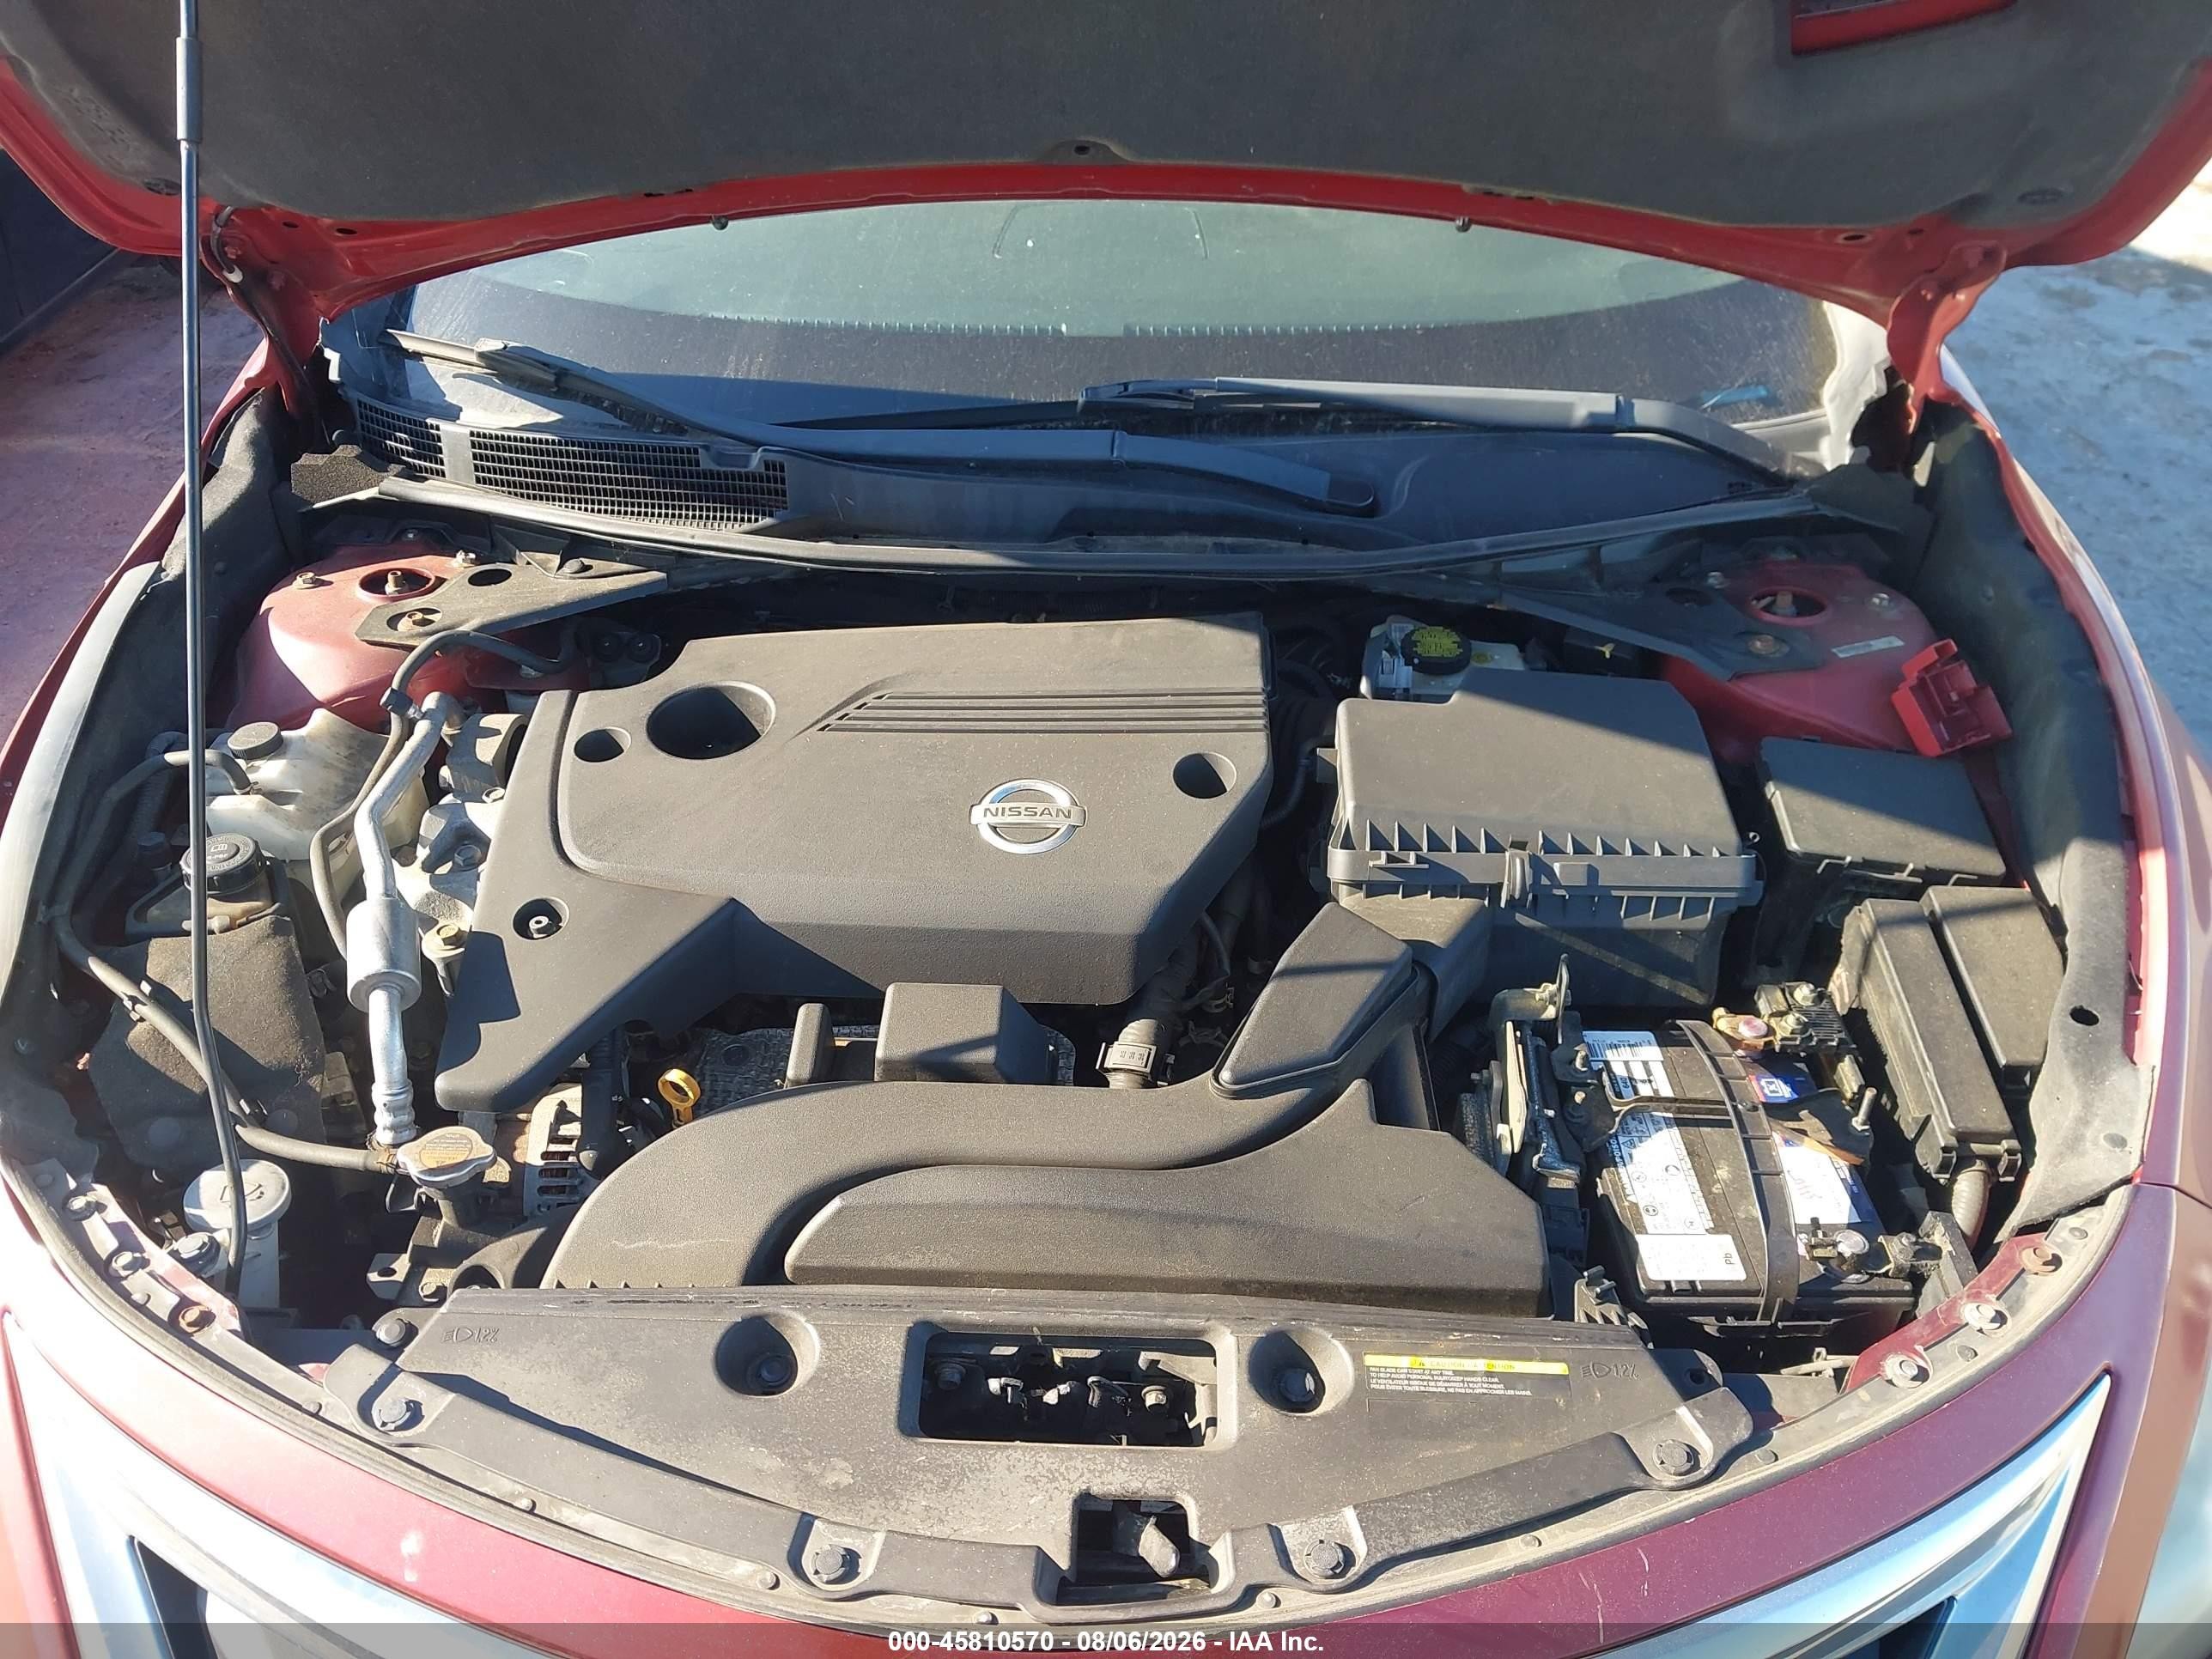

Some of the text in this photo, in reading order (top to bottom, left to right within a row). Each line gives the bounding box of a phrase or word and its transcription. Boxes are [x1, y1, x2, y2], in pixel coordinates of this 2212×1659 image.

[983, 806, 1072, 818] NISSAN
[1620, 1077, 1630, 1089] 640
[1723, 1252, 1735, 1265] Pb
